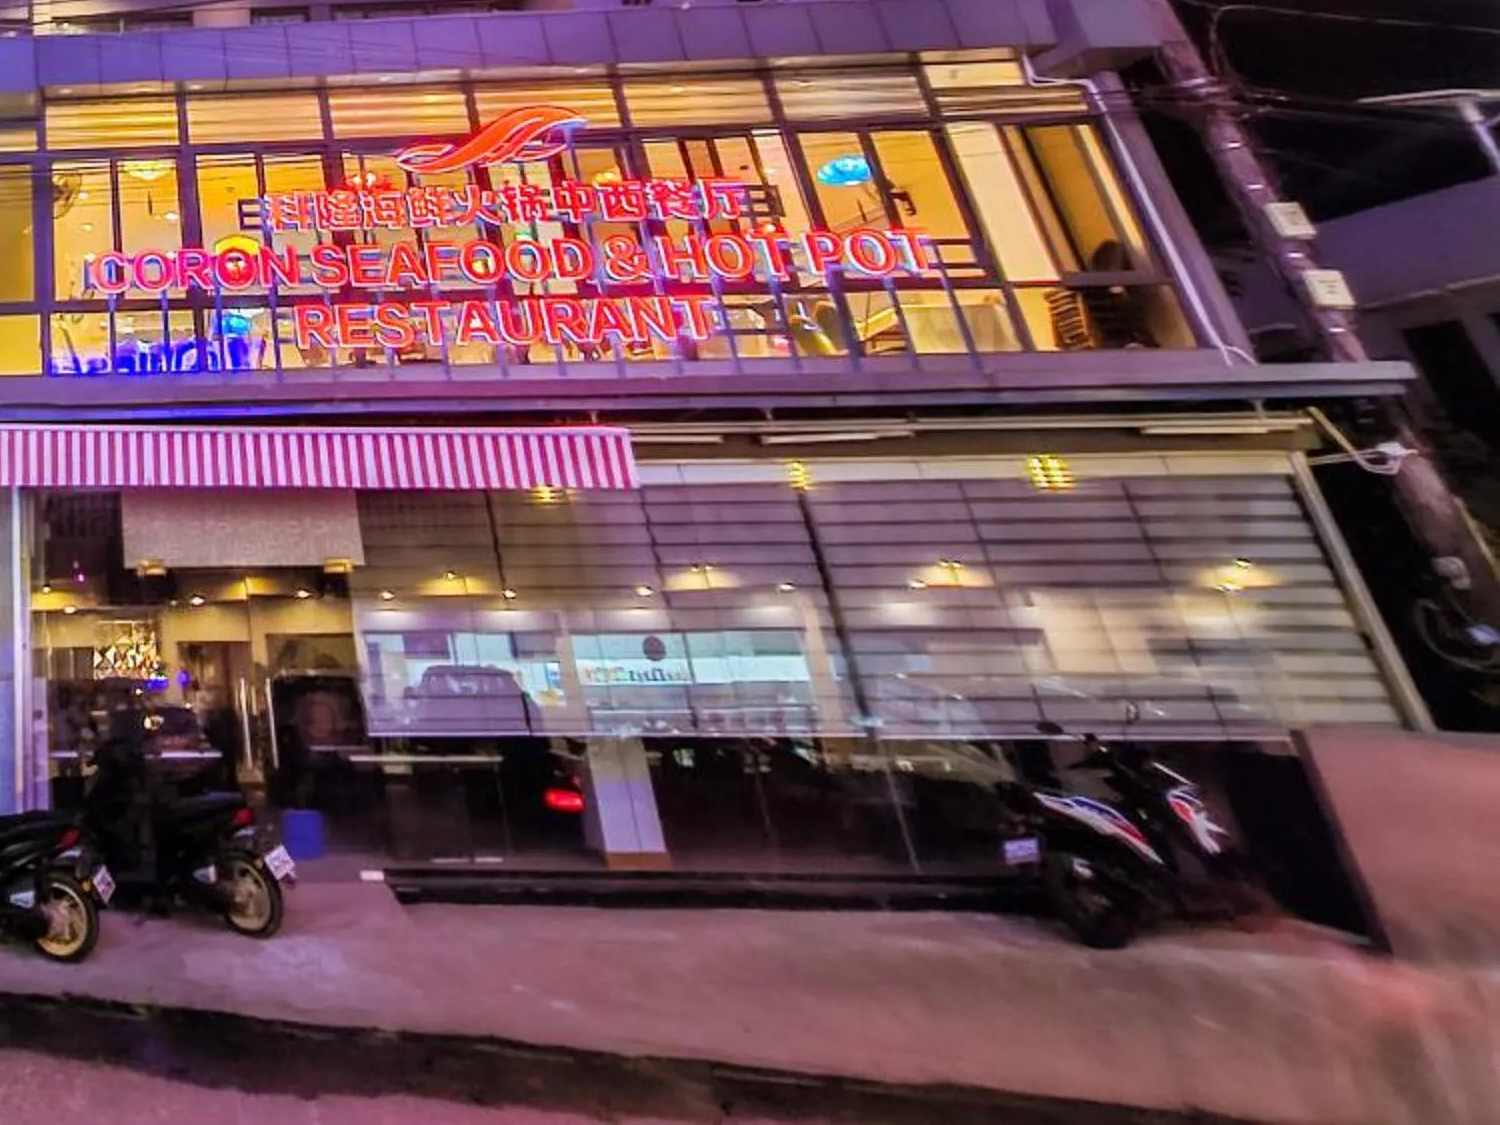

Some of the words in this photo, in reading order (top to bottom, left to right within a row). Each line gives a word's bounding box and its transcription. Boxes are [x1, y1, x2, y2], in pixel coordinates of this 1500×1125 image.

[90, 242, 300, 294] CORON
[310, 237, 594, 288] SEAFOOD
[604, 232, 651, 283] &
[660, 228, 790, 280] HOT
[805, 227, 933, 277] POT
[294, 295, 716, 352] RESTAURANT
